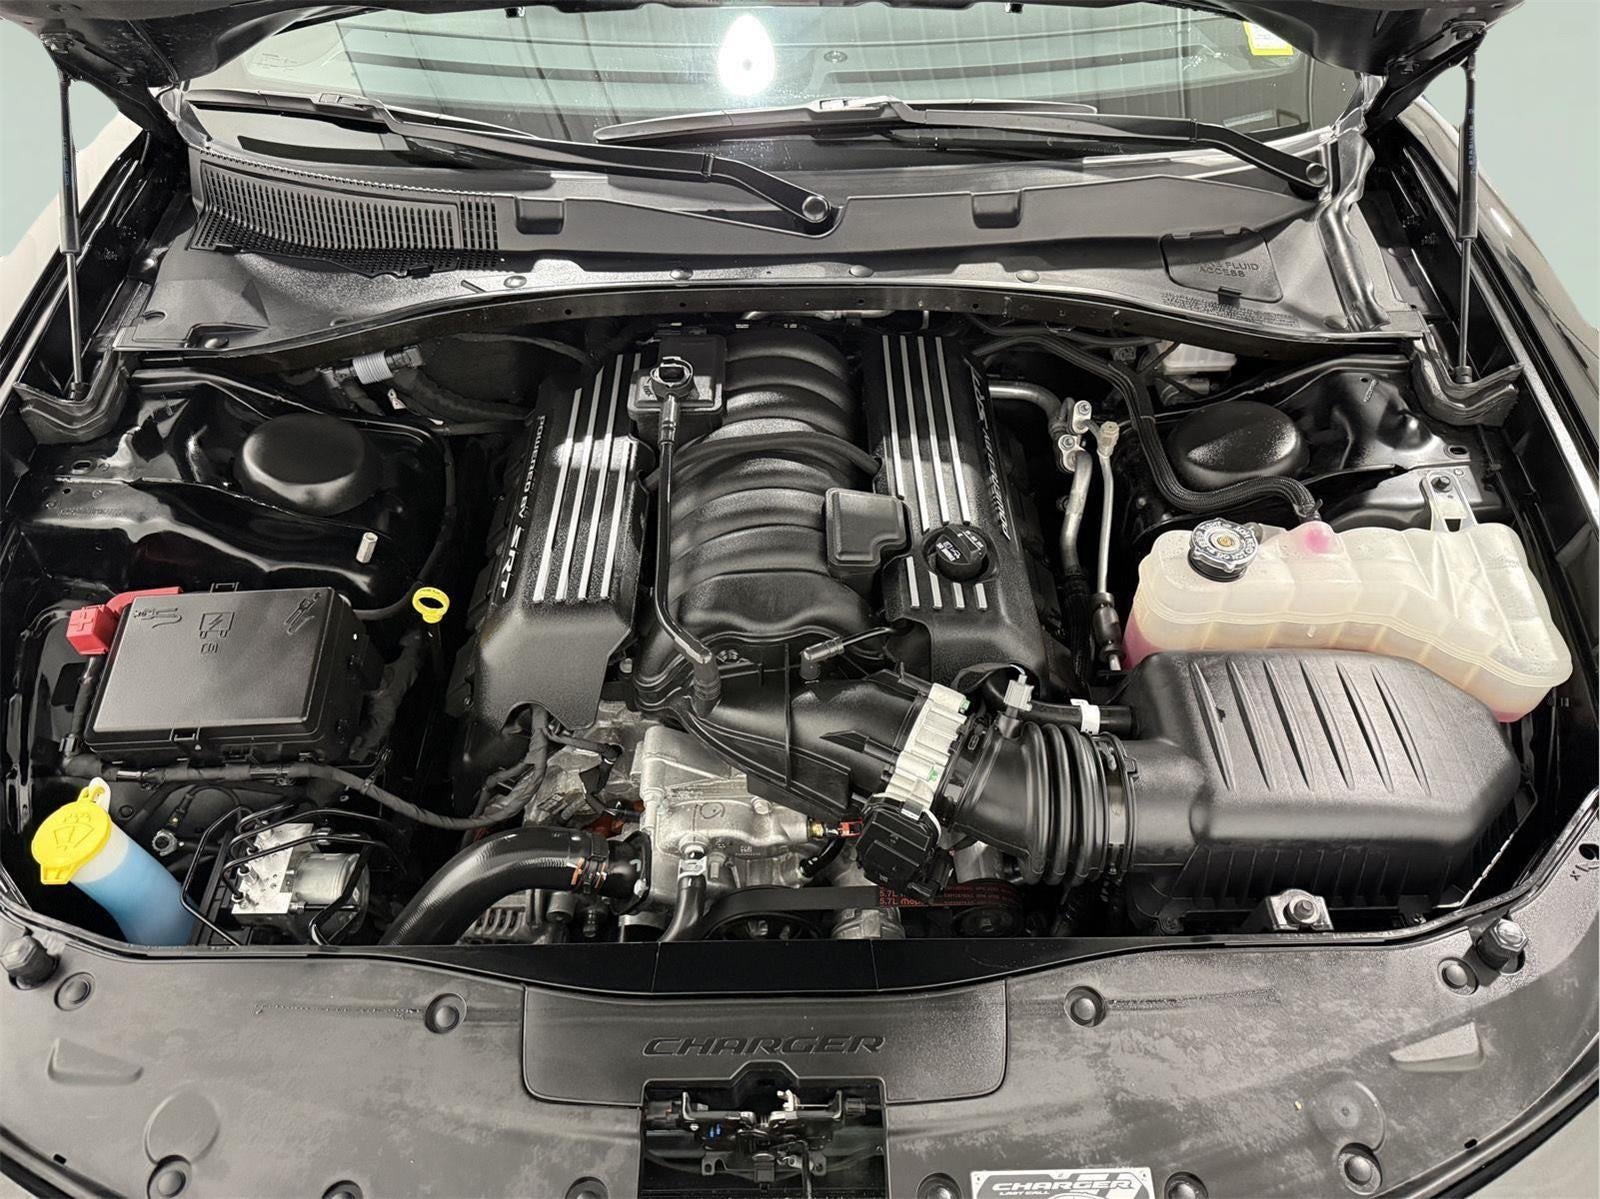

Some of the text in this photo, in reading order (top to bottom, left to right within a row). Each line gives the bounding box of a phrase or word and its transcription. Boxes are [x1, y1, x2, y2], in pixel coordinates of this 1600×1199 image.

[1225, 262, 1259, 271] FLUID
[523, 415, 546, 493] POWERED
[501, 524, 523, 598] SRT
[642, 1035, 886, 1056] CHARGER
[992, 1180, 1134, 1191] CHARGER
